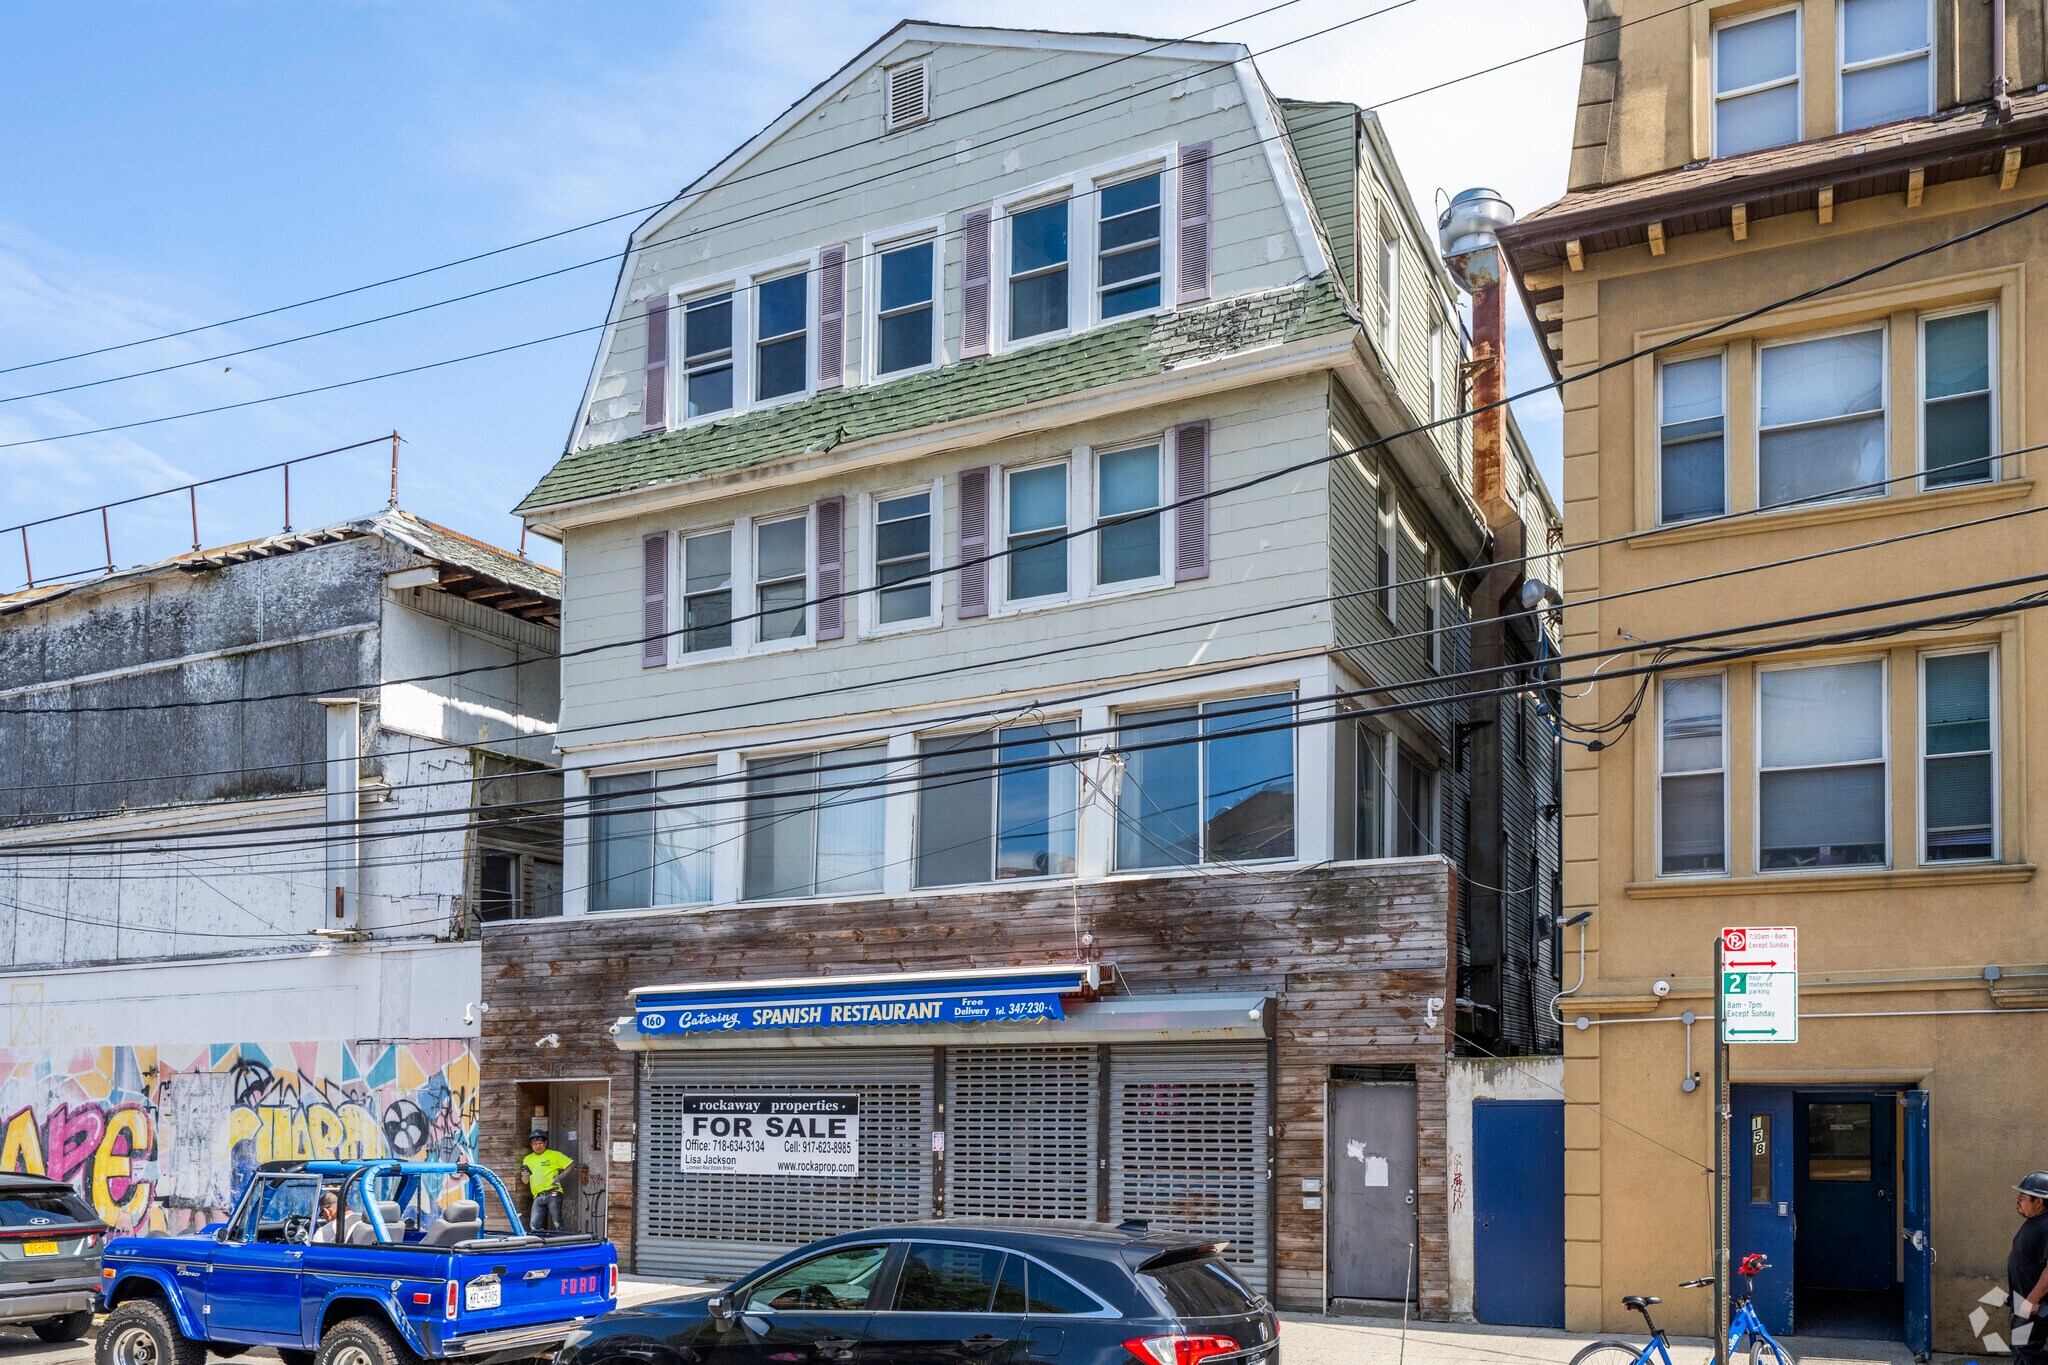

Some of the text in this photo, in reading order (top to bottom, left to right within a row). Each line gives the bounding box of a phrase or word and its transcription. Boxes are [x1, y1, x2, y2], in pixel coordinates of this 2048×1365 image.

[1770, 941, 1790, 949] Sunday
[1729, 974, 1741, 993] 2
[962, 998, 984, 1007] Free
[1727, 1001, 1742, 1009] 8am
[1748, 1001, 1763, 1010] 7pm
[645, 1001, 943, 1029] 160 Catering SPANISH RESTAURANT
[954, 1006, 990, 1017] Delivery
[995, 1007, 1006, 1016] Tel.
[1727, 1009, 1776, 1018] Except Sunday
[699, 1099, 839, 1114] rockaway properties
[692, 1116, 847, 1139] FOR SALE
[685, 1139, 765, 1152] Office: 718-634-3134
[784, 1140, 851, 1154] Cell: 917-623-8985
[685, 1154, 737, 1165] Lisa Jackson
[777, 1160, 855, 1175] www.rockaprop.com
[561, 1275, 597, 1296] FORD
[136, 1318, 148, 1327] T/A
